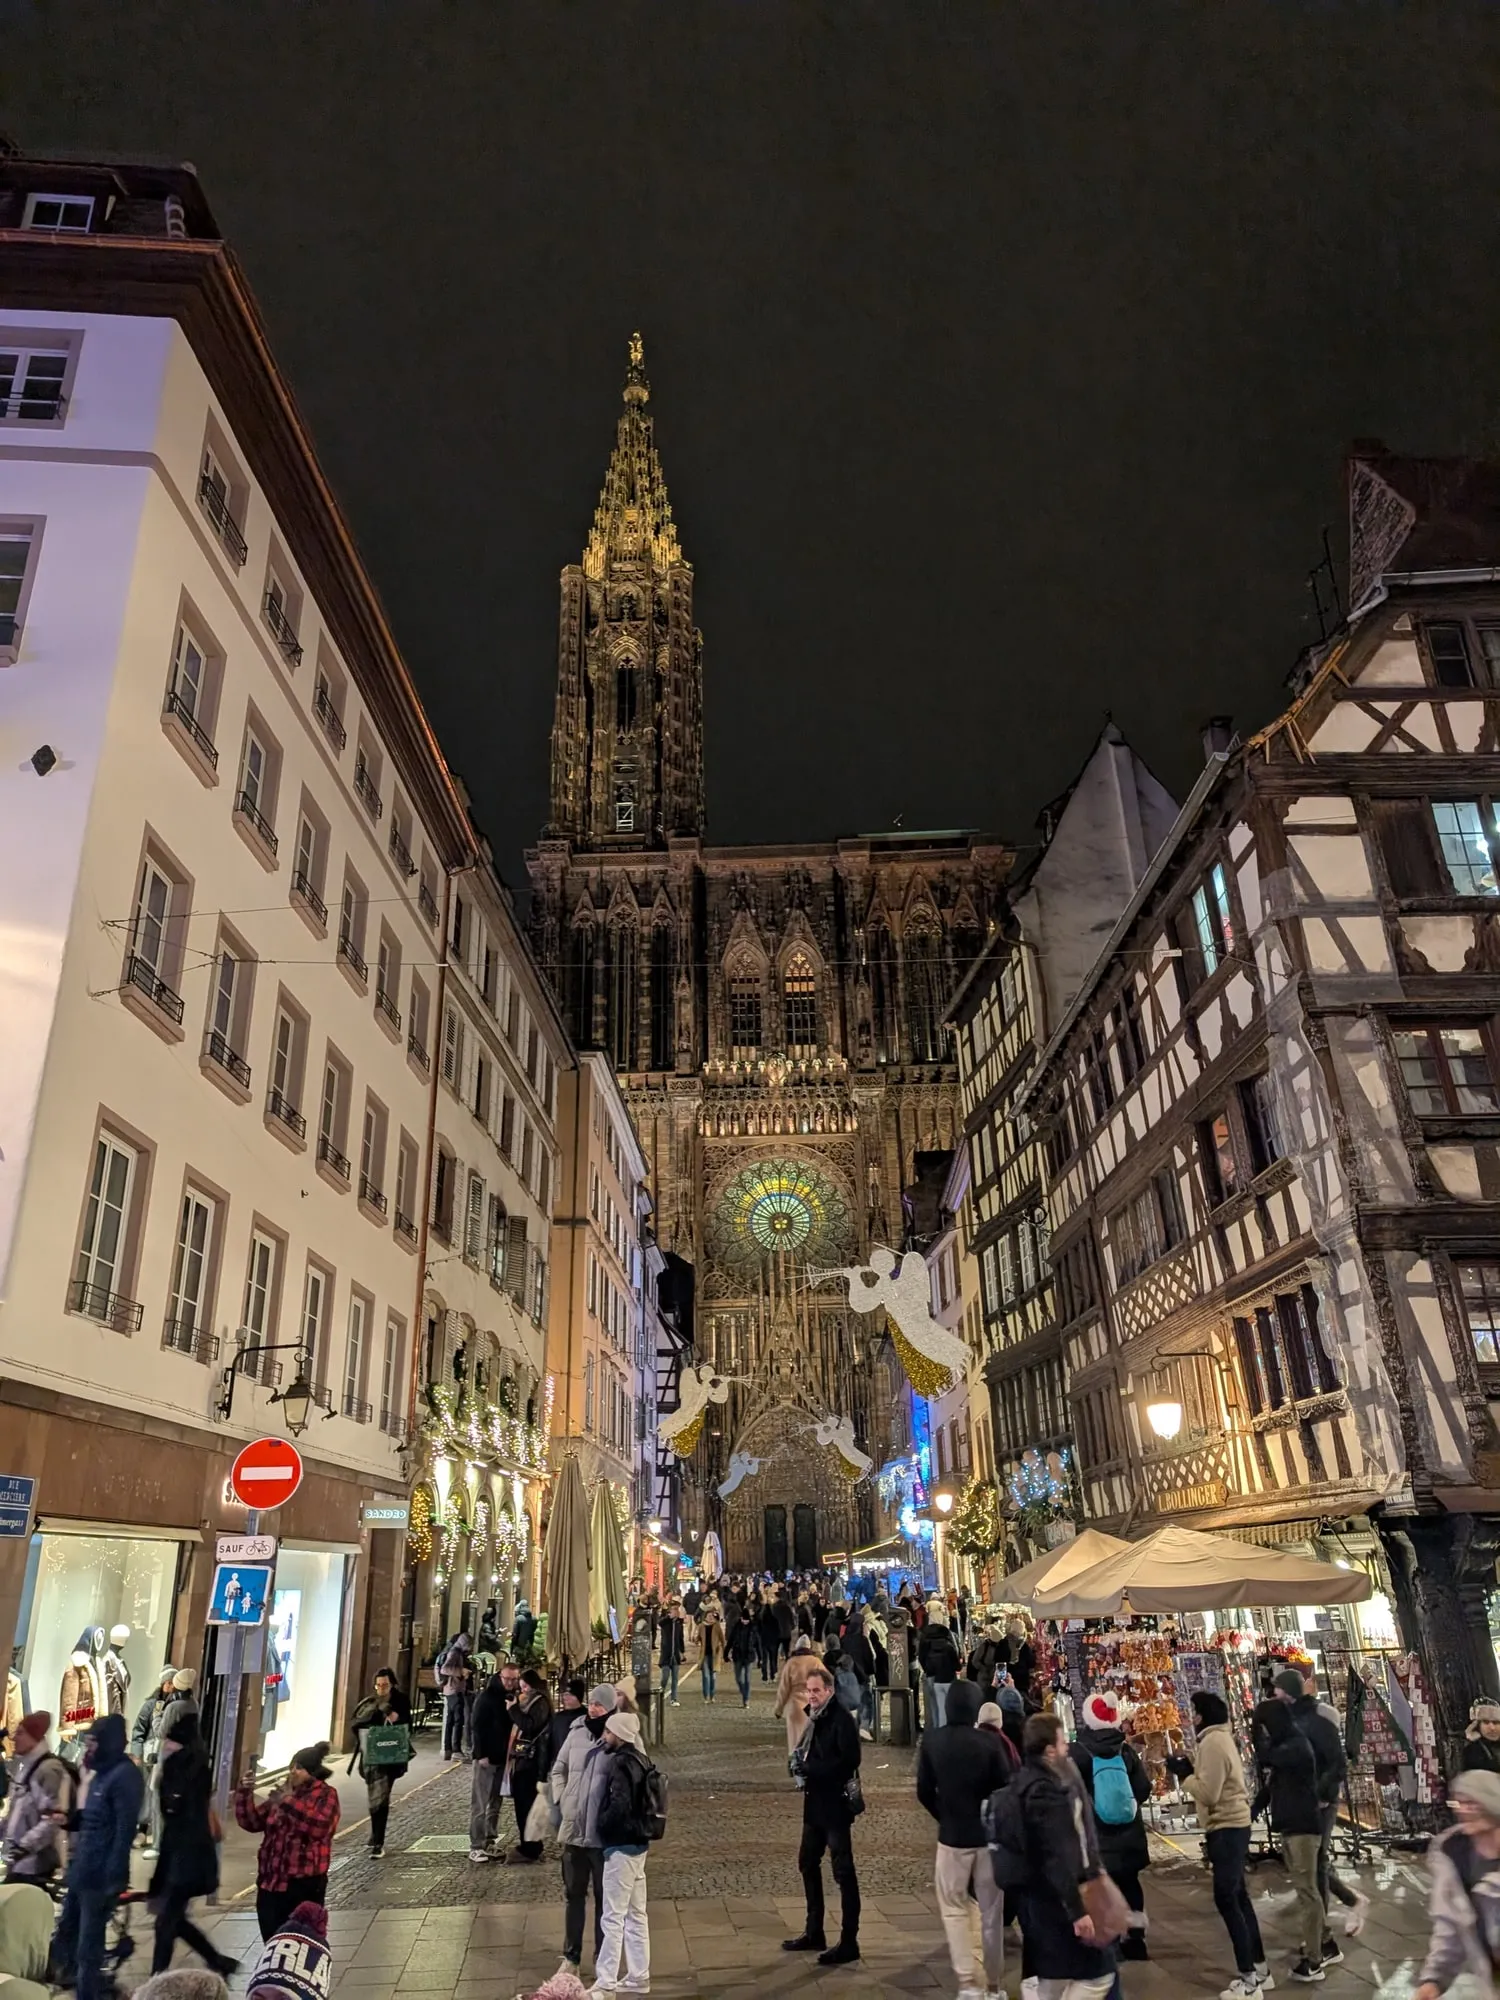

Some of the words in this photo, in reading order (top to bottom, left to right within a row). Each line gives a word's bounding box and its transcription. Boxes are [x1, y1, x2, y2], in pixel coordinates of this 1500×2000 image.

[366, 1509, 407, 1519] SANDRO
[219, 1544, 244, 1554] SAUF
[254, 1938, 333, 1998] ERLA
